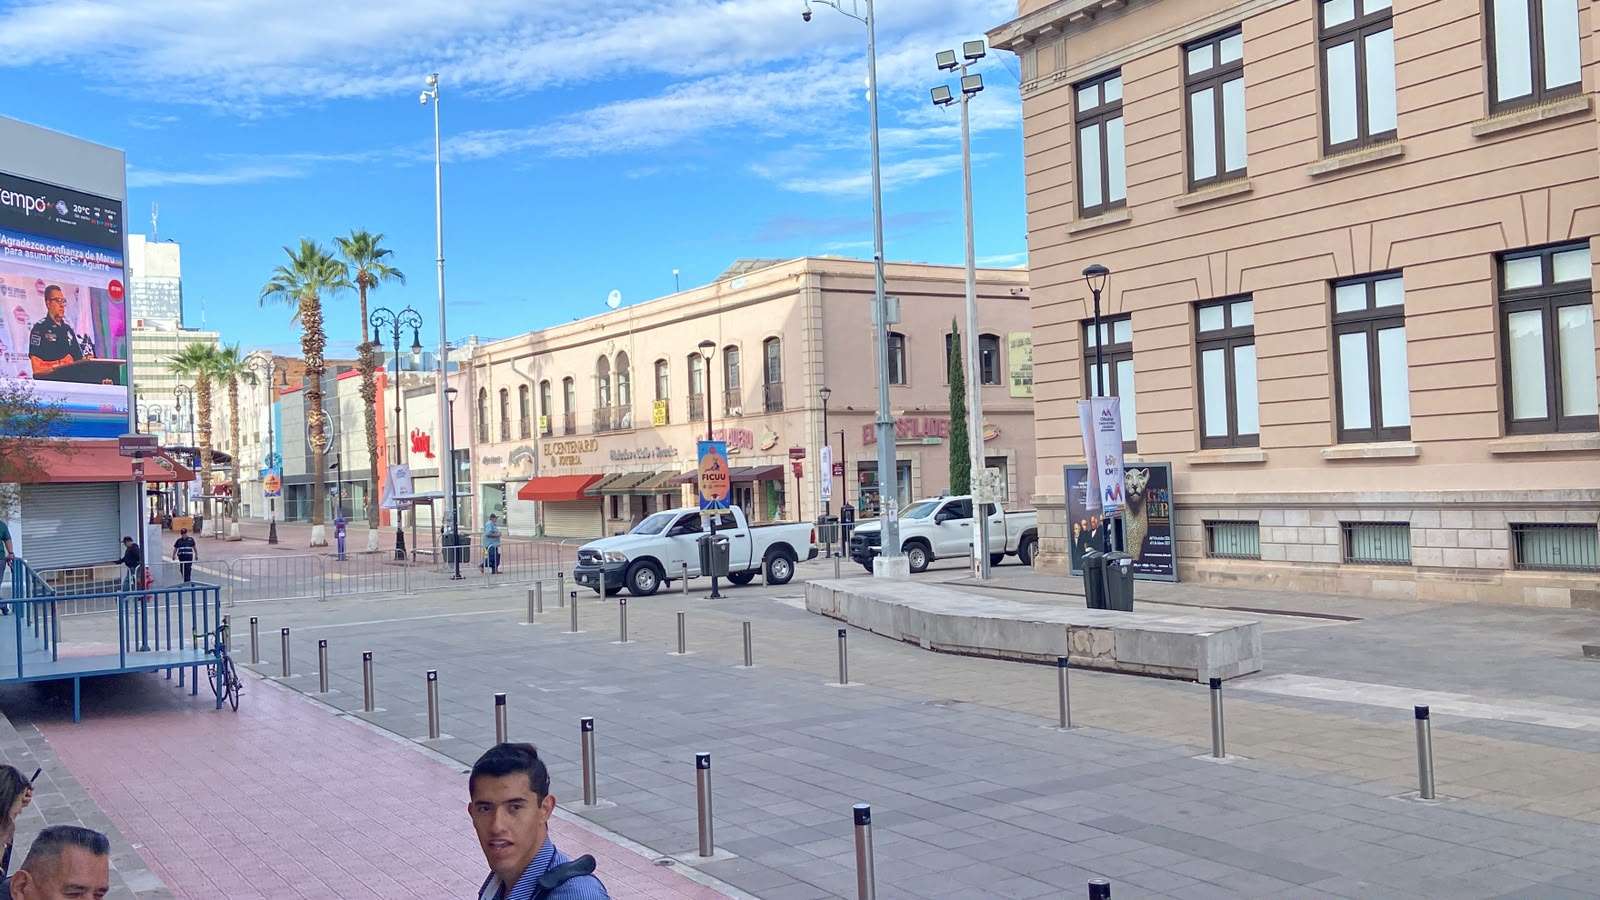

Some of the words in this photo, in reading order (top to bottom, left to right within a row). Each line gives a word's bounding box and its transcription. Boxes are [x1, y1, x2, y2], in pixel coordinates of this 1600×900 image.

[0, 187, 46, 216] empo
[4, 246, 23, 257] para
[24, 249, 52, 261] asumir
[83, 259, 110, 271] Aguirre
[46, 244, 84, 258] confianza
[85, 249, 95, 261] de
[96, 252, 115, 264] Maru
[702, 473, 726, 481] FICUU
